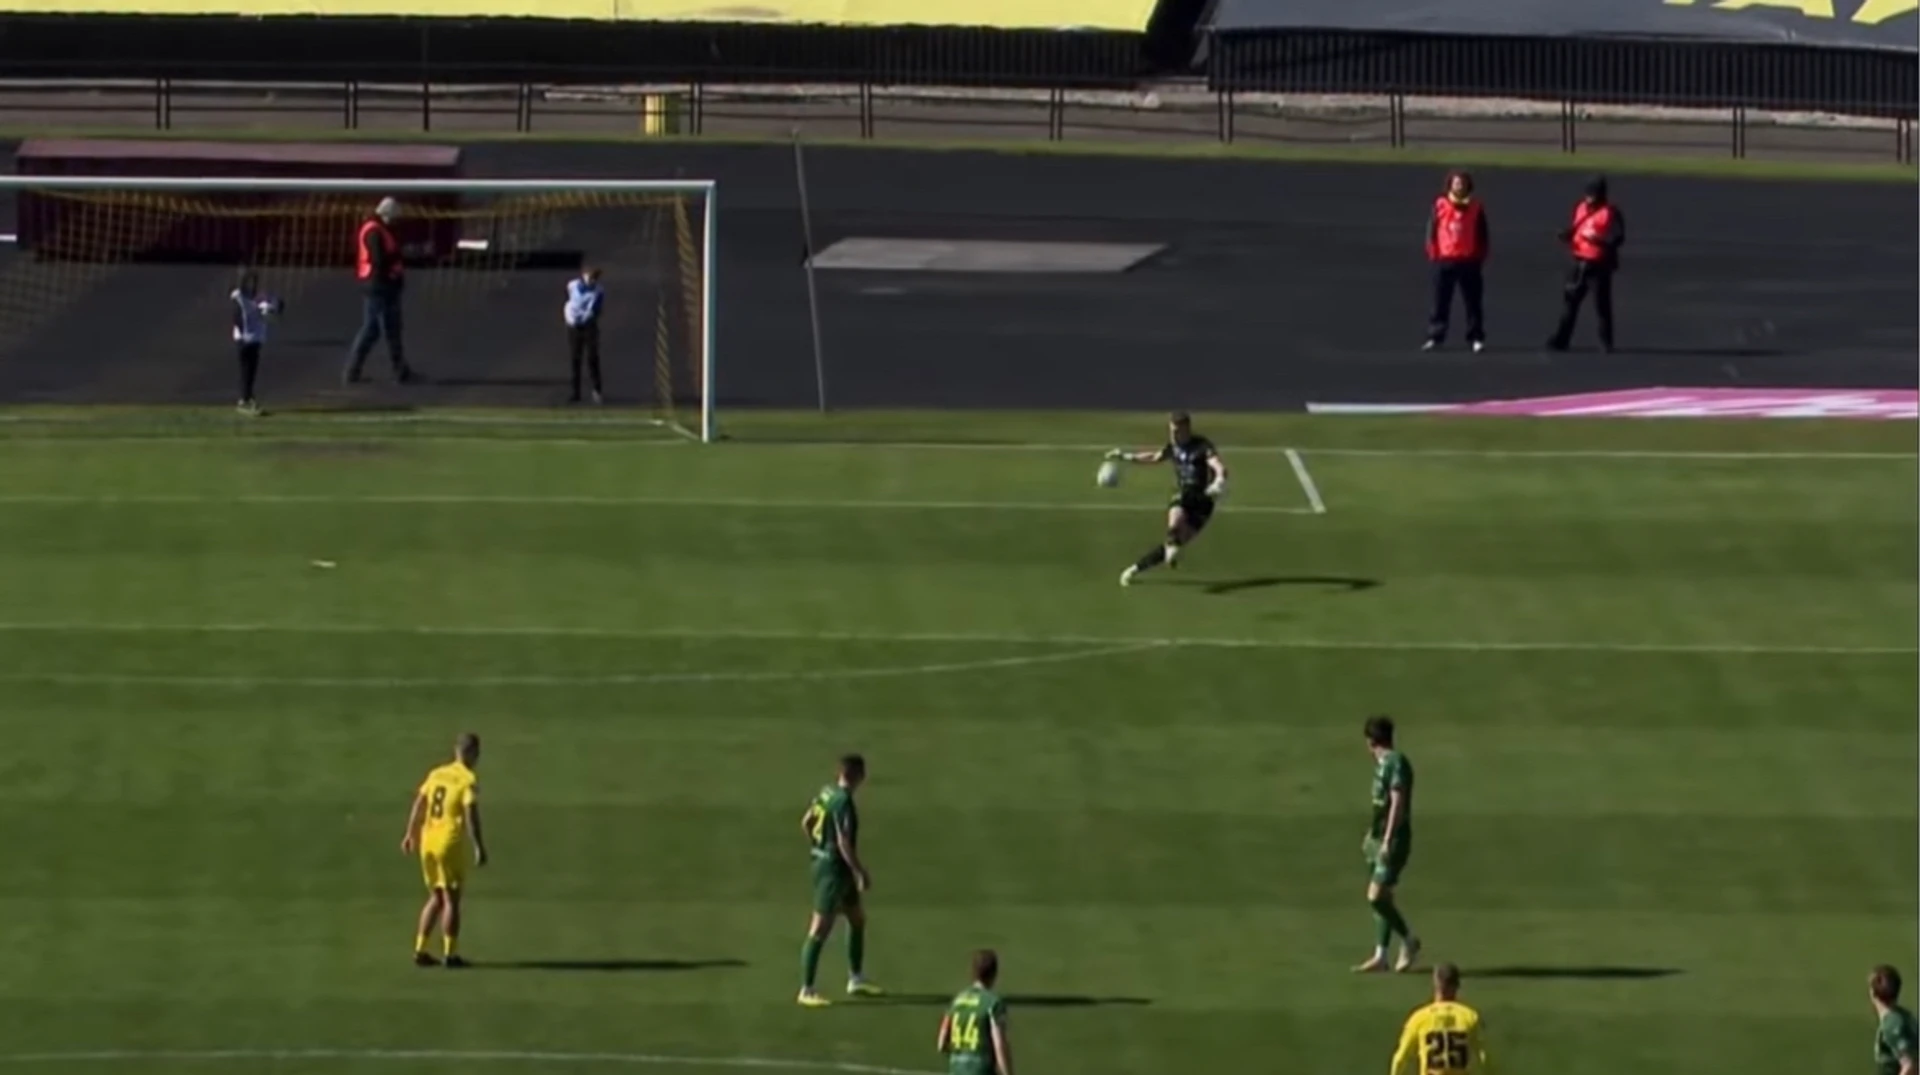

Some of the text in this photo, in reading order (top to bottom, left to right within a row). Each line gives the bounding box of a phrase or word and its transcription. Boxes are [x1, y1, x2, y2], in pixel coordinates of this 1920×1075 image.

[431, 785, 447, 819] 8
[951, 1012, 979, 1051] 44
[1426, 1031, 1468, 1069] 25
